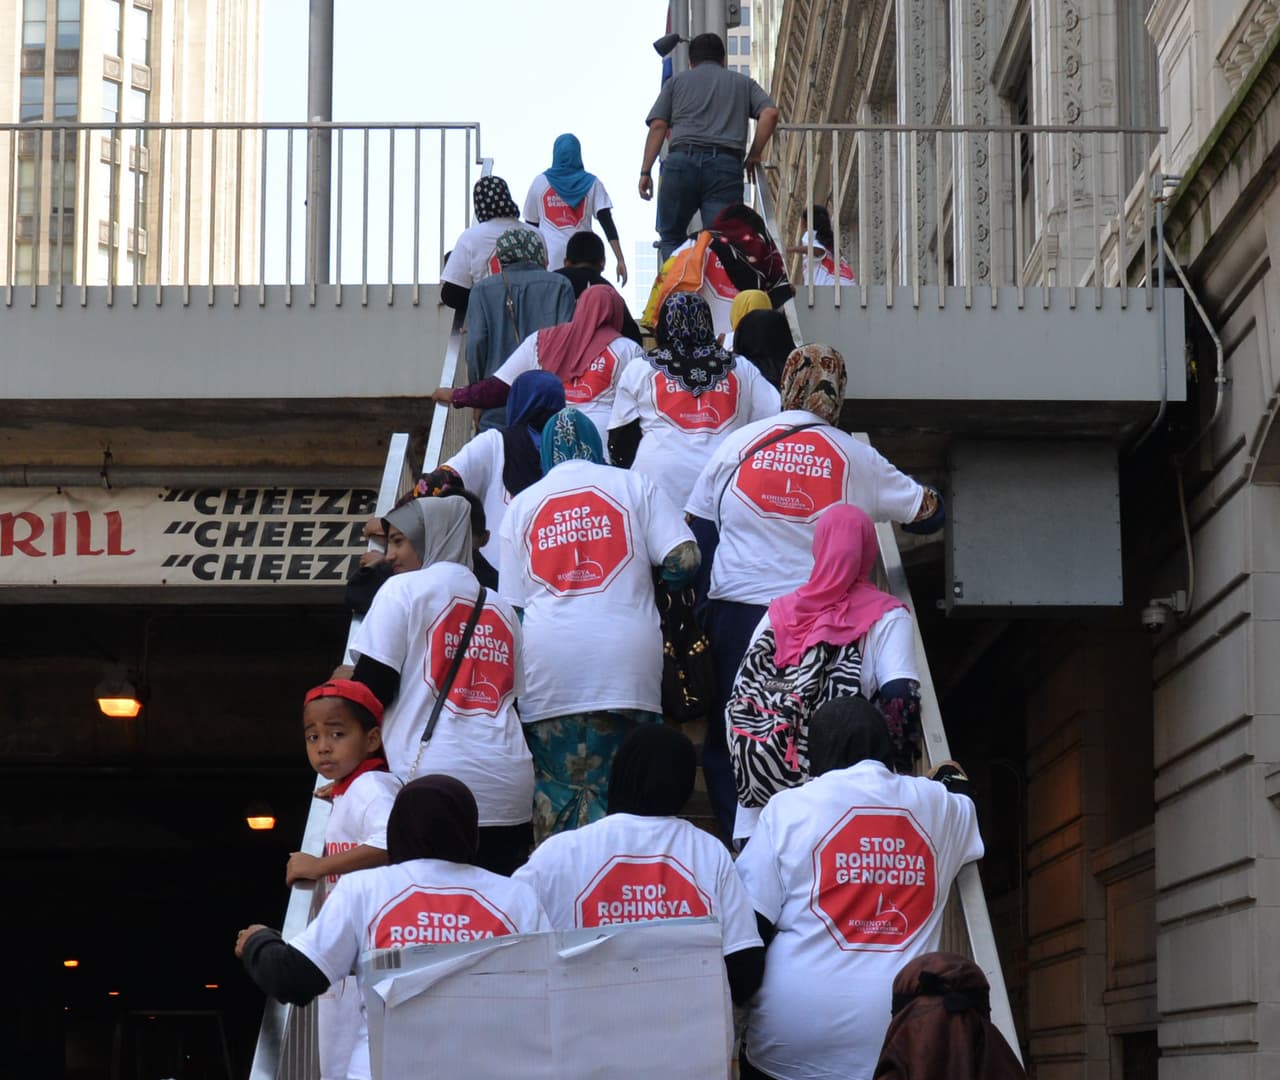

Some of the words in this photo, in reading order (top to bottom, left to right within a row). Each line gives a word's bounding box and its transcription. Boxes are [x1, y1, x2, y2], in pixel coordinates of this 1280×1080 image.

[776, 442, 815, 453] STOP
[754, 450, 832, 468] ROHINGYA
[752, 460, 831, 478] GENOCIDE
[554, 506, 591, 523] STOP
[538, 515, 611, 540] ROHINGYA
[538, 527, 612, 550] GENOCIDE
[459, 622, 494, 636] SOP
[444, 632, 509, 654] ROINGYA
[860, 837, 905, 852] STOP
[835, 852, 926, 870] ROHINGYA
[836, 869, 925, 886] GENOCIDE
[622, 884, 665, 900] STOP
[598, 899, 691, 917] ROHINGYA
[417, 911, 470, 928] STOP
[390, 926, 494, 942] ROHINGYA
